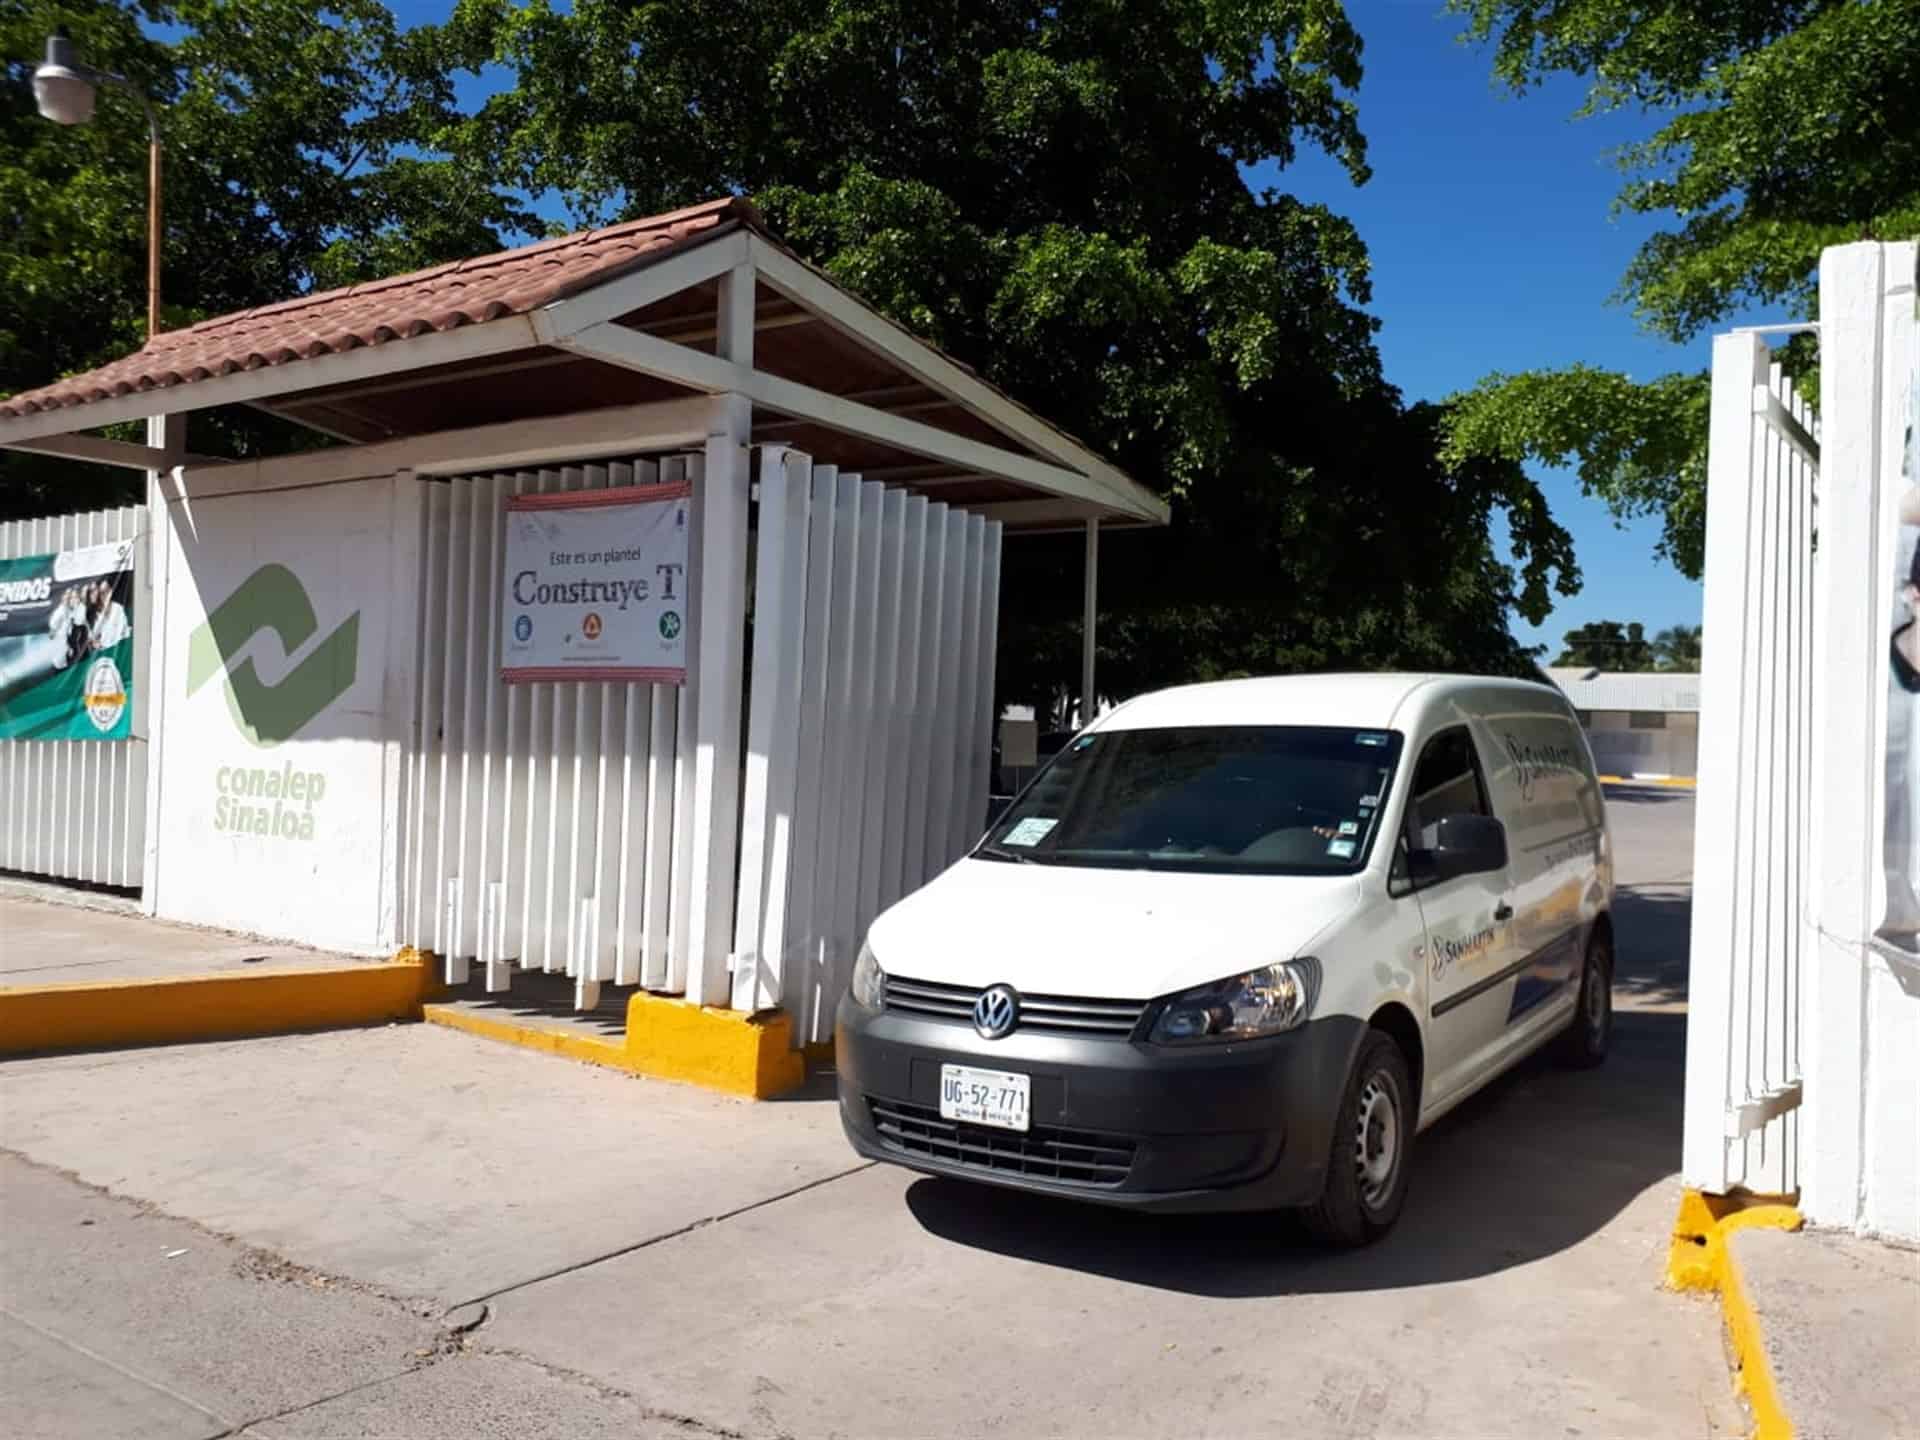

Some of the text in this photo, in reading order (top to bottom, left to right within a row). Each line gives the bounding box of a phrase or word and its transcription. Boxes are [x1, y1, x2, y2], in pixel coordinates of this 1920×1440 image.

[550, 546, 641, 566] Este es un plantel
[512, 563, 683, 610] Construye T
[215, 760, 326, 810] conalep
[213, 795, 315, 841] Sinaloa
[944, 1078, 1026, 1113] UG-52-771
